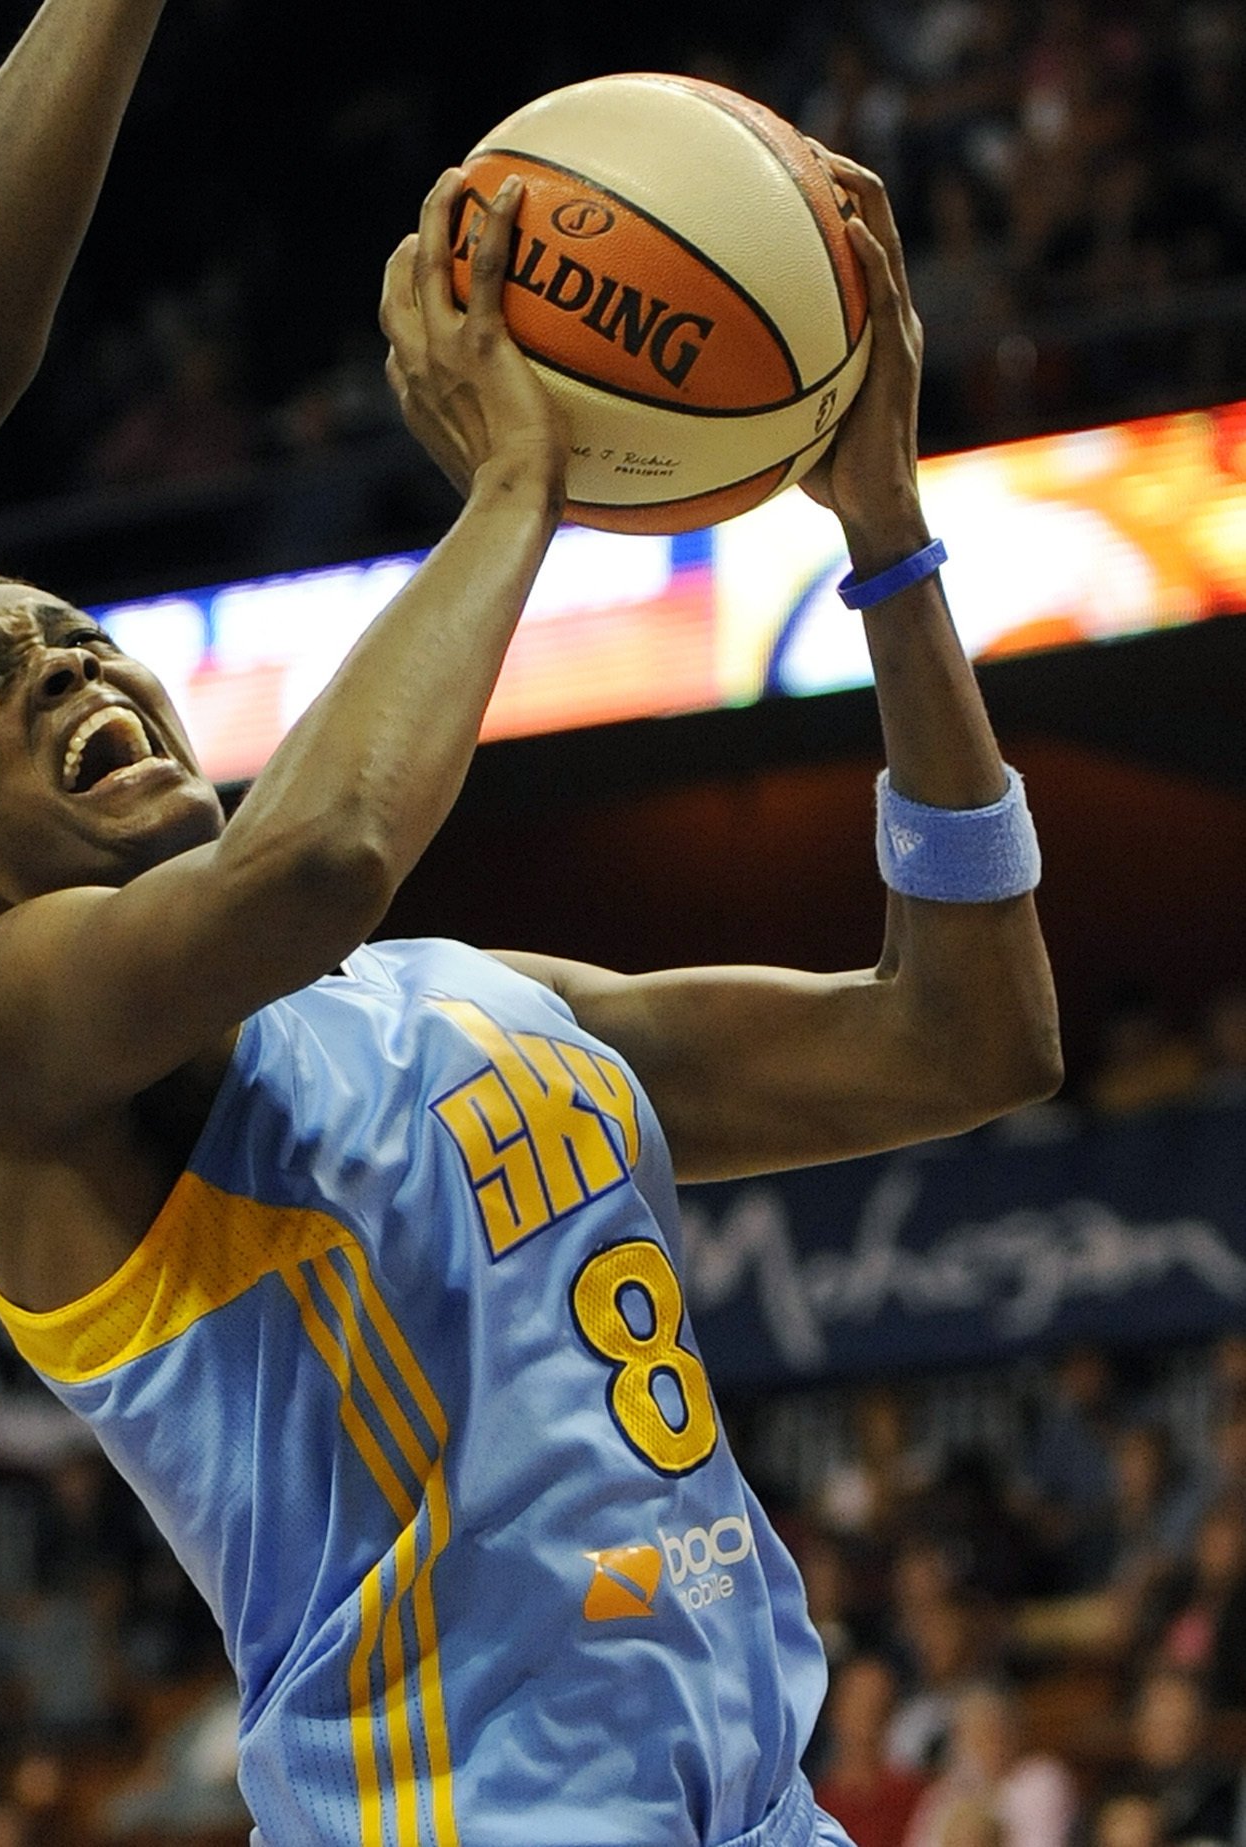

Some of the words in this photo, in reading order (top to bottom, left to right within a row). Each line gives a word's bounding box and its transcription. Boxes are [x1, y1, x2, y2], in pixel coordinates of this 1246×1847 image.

[454, 208, 714, 389] ALDING
[426, 992, 642, 1266] SKY
[570, 1238, 718, 1477] 8
[657, 1515, 752, 1585] boo
